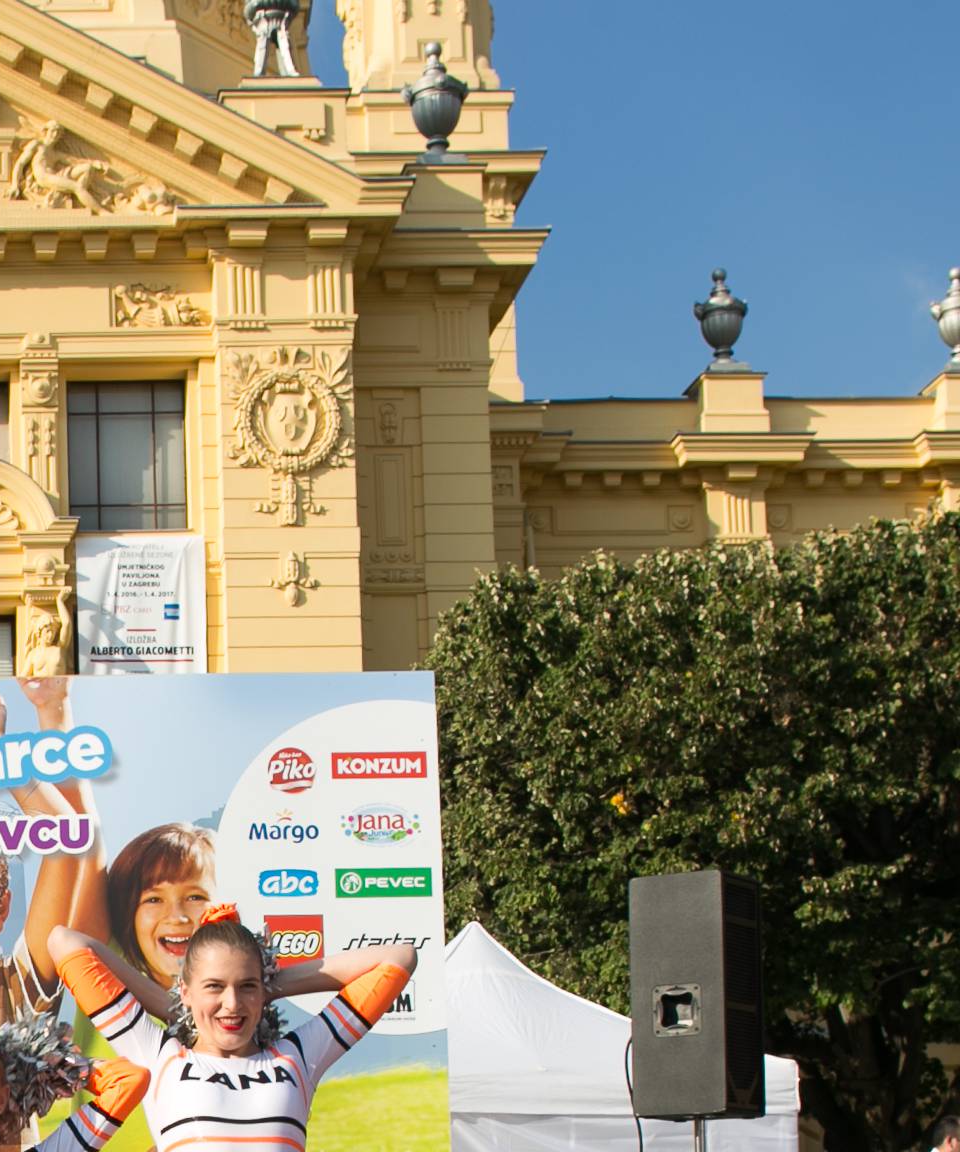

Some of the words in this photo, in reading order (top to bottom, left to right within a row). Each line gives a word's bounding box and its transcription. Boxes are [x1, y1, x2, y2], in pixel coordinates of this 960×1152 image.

[90, 646, 133, 655] ALBERTO
[136, 646, 194, 655] GIACOMETTI
[268, 758, 317, 783] Piko
[337, 757, 421, 775] KONZUM
[248, 822, 319, 843] Margo
[262, 871, 315, 895] abc
[364, 876, 426, 889] PEVEC
[179, 1062, 296, 1090] LANA
